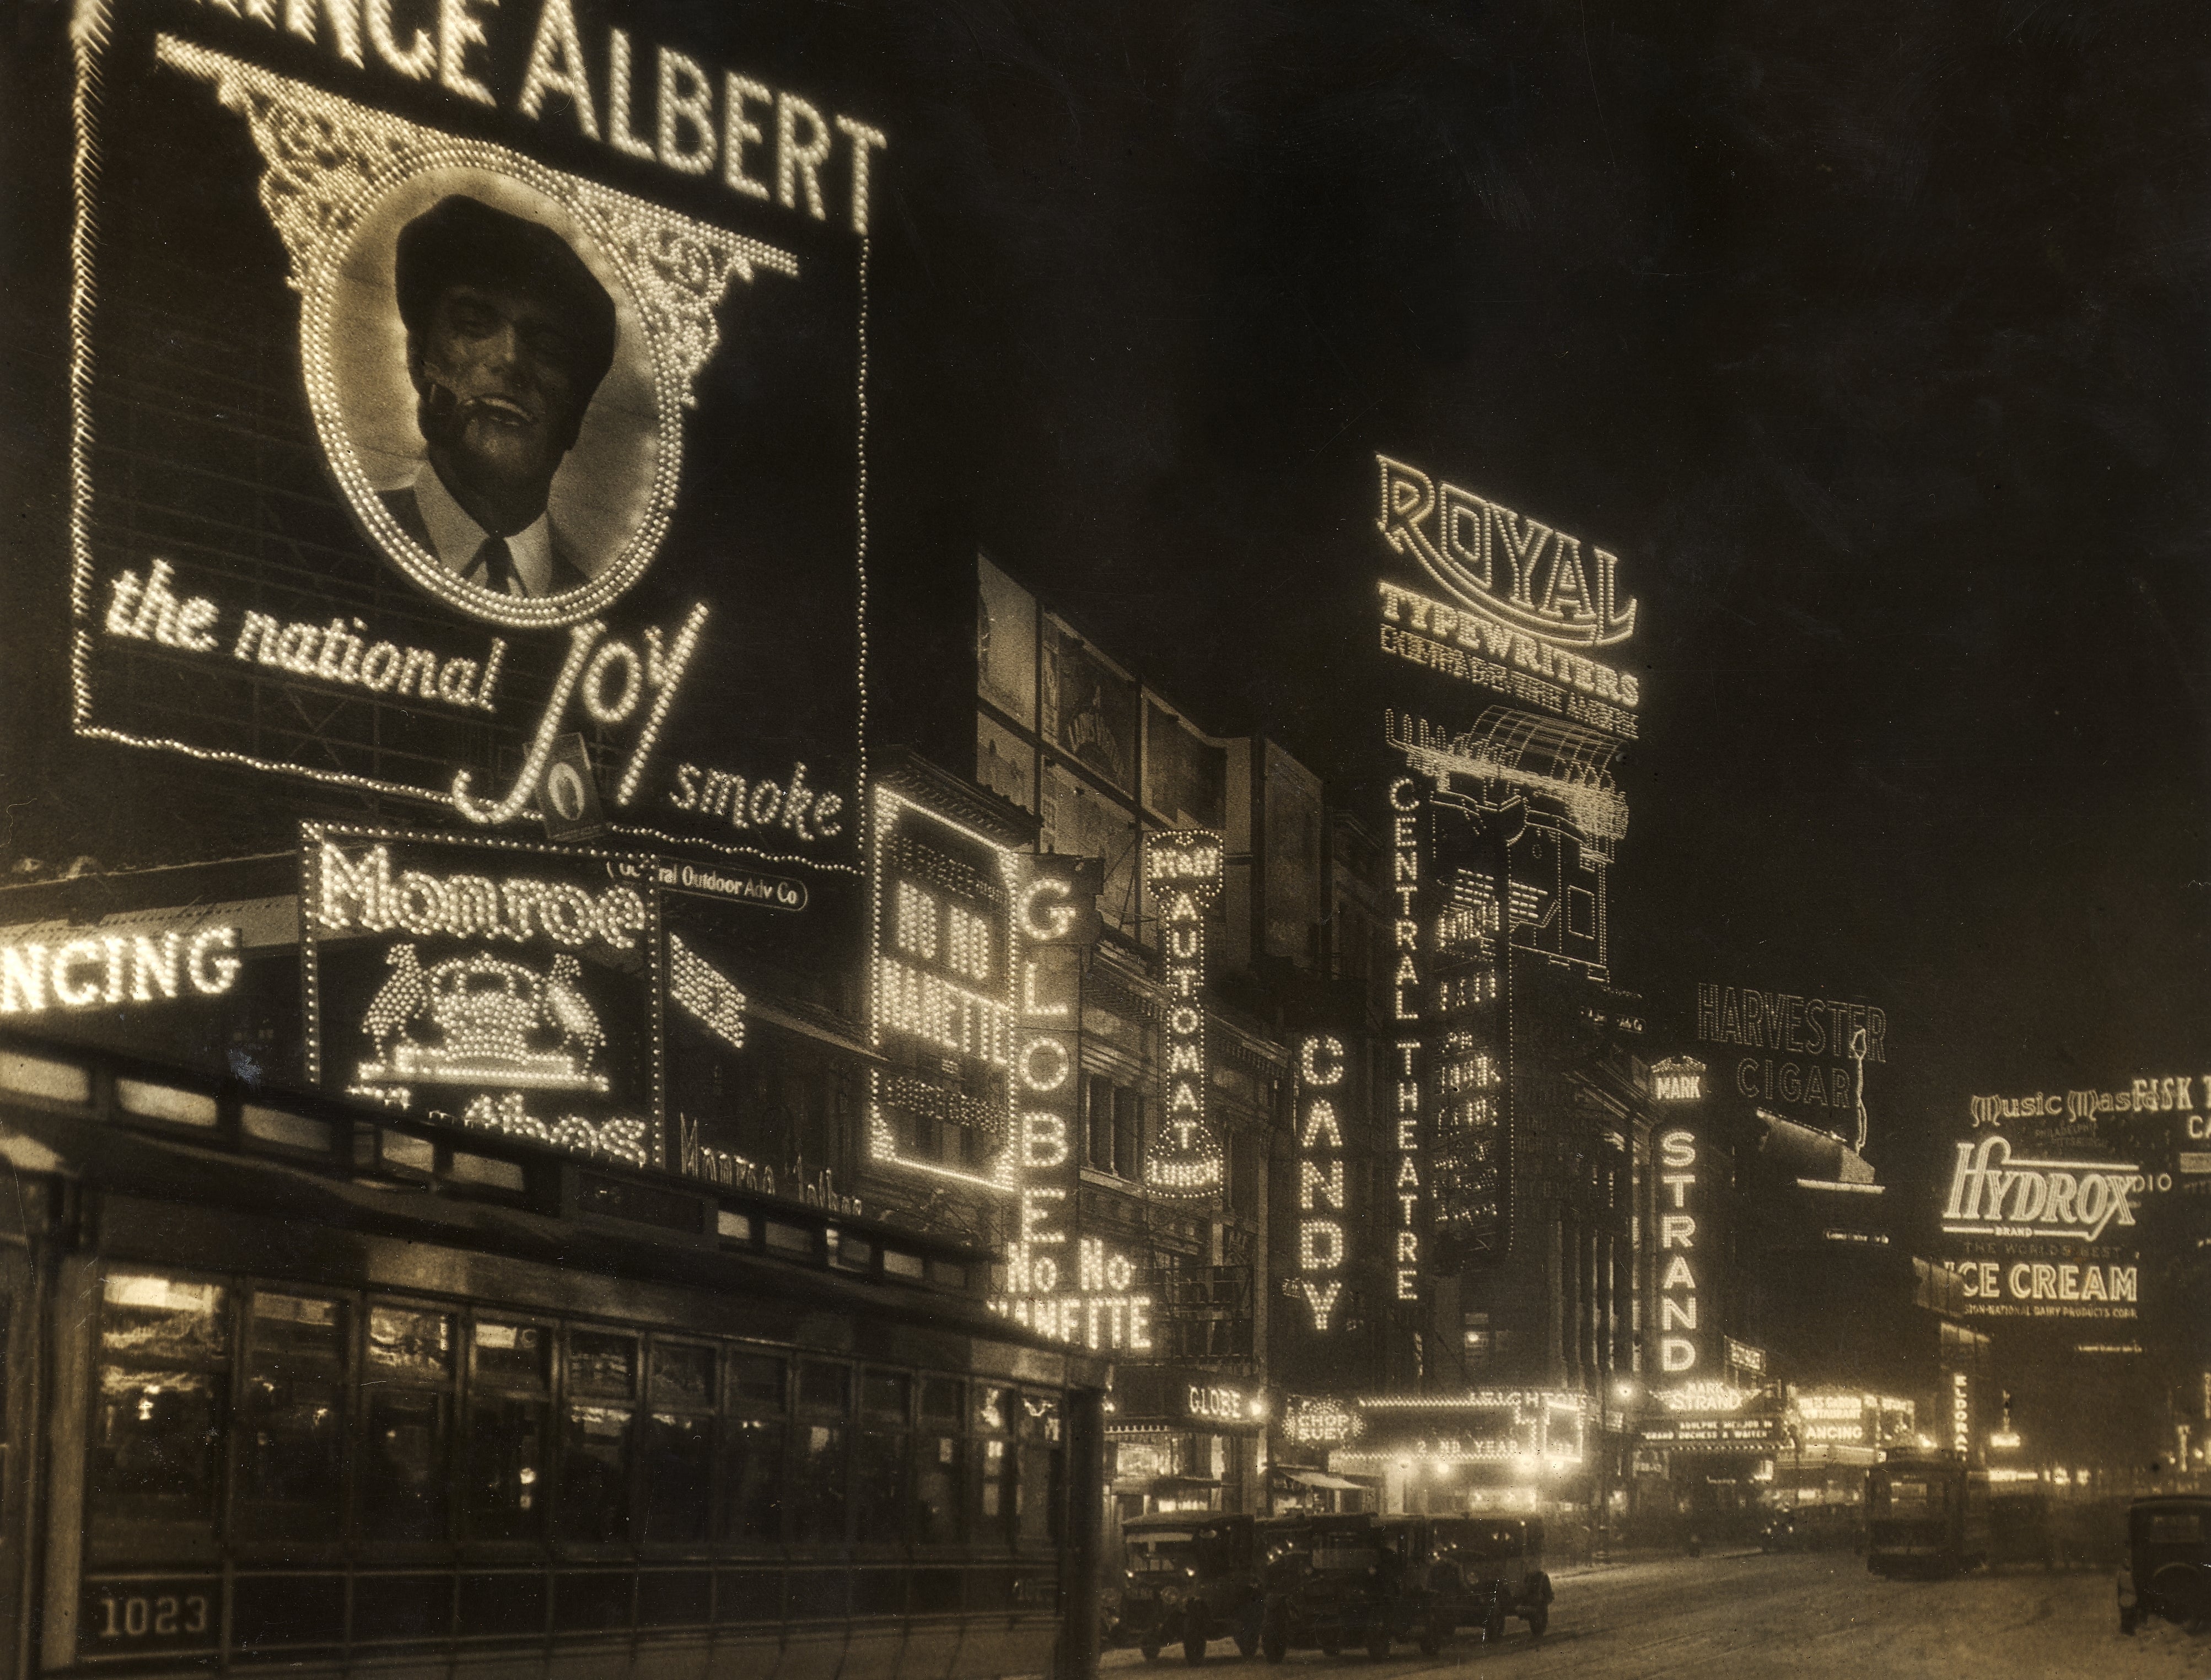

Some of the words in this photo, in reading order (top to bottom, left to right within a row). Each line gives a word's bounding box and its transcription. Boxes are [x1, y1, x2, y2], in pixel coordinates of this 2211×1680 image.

[517, 0, 889, 236] ALBERT
[1377, 454, 1637, 647] ROYAL
[105, 557, 219, 653] the
[234, 608, 507, 713] national
[1378, 580, 1639, 708] TYPEWRITERS
[319, 843, 647, 949] Monroe
[682, 865, 742, 895] Outdoor
[744, 877, 772, 899] Adv
[1390, 778, 1421, 1020] CENTRAL
[1020, 878, 1076, 1243] GLOBE
[1171, 890, 1199, 1150] AUTOMAT
[1699, 982, 1886, 1063] HARVESTER
[1657, 1076, 1701, 1100] MARK
[1736, 1058, 1850, 1109] CIGAR
[1971, 1091, 2063, 1127] Music
[2132, 1077, 2194, 1112] FISK
[1301, 1035, 1344, 1330] CANDY
[1396, 1040, 1421, 1300] THEATRE
[1943, 1136, 2137, 1226] HYDROX
[1661, 1131, 1697, 1371] STRAND
[1995, 1227, 2034, 1238] BRAND
[1944, 1262, 2000, 1298] CE
[2008, 1263, 2138, 1302] CREAM
[1189, 1385, 1241, 1418] GLOBE
[1297, 1428, 1349, 1441] SUEY
[1298, 1414, 1351, 1428] CHOP
[100, 1597, 208, 1636] 1023
